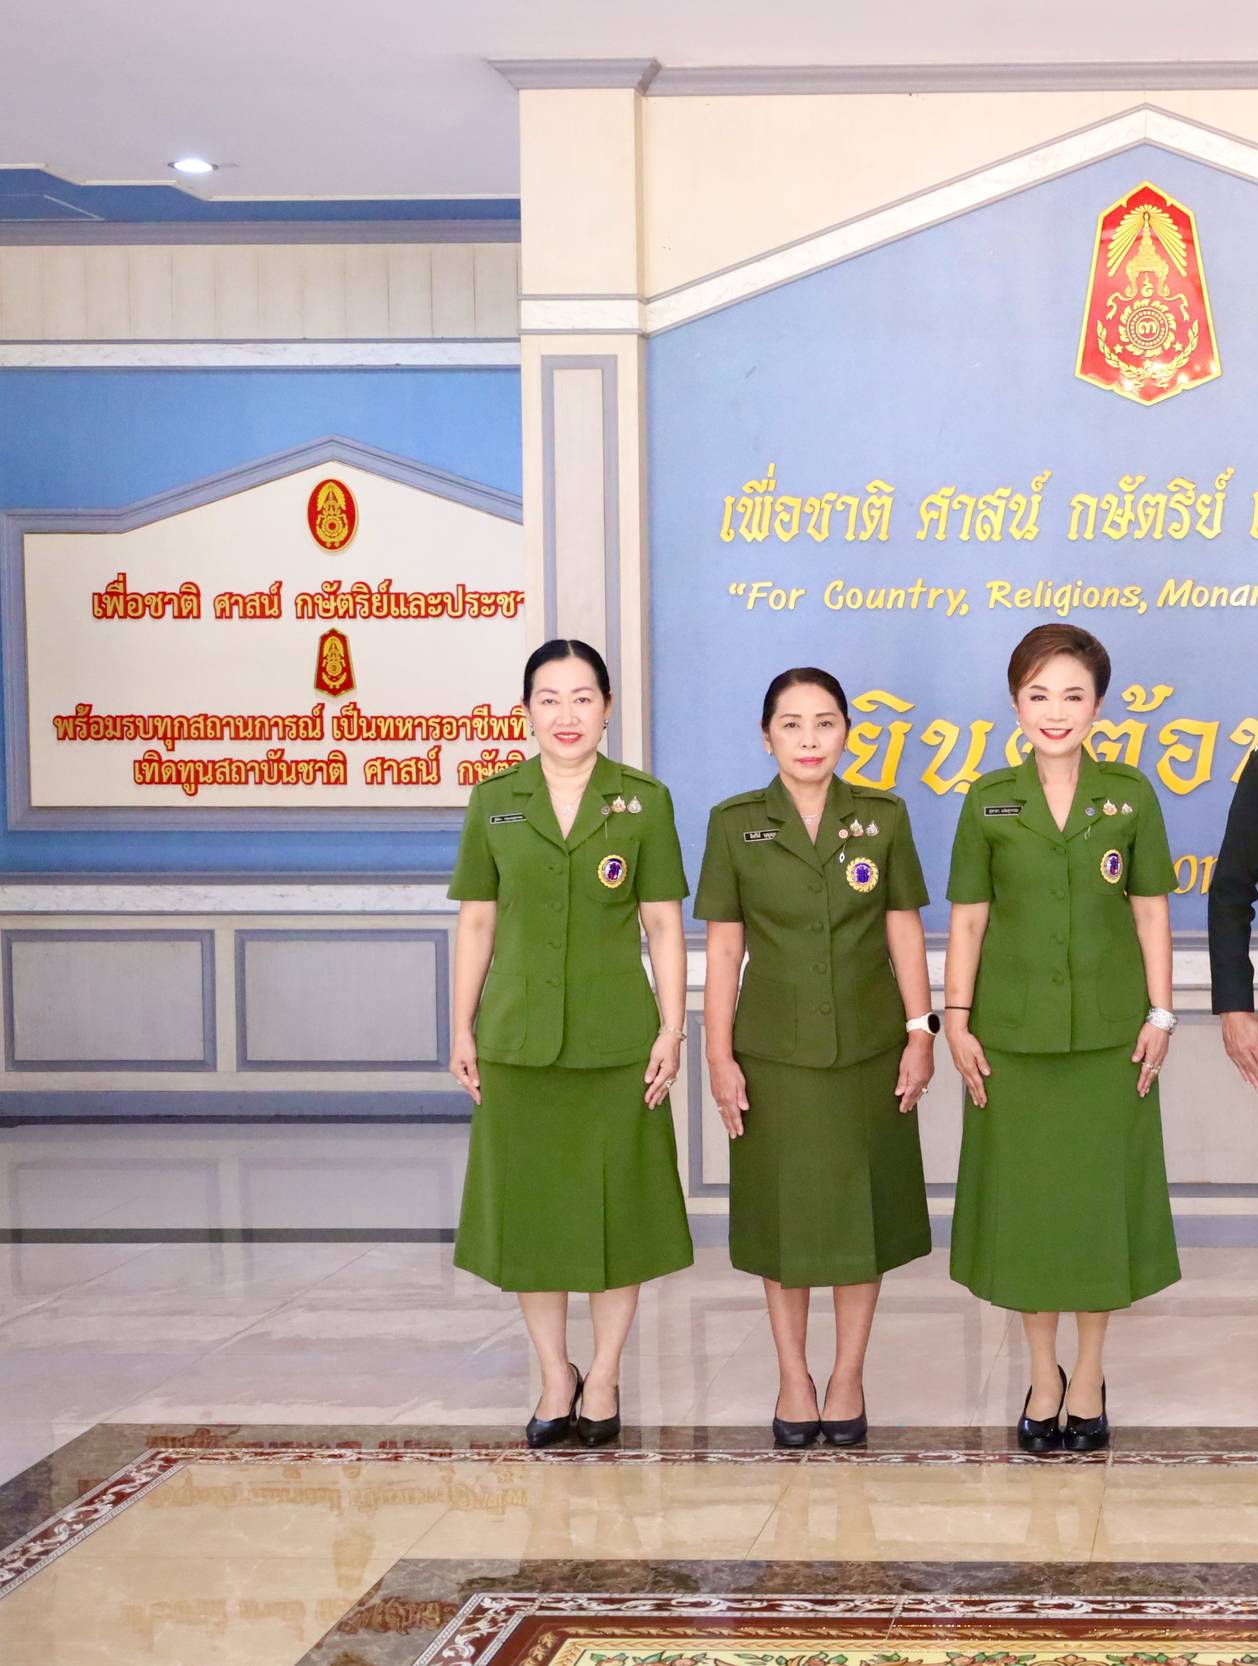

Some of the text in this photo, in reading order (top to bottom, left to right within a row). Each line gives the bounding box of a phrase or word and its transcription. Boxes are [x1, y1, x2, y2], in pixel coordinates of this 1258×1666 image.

[720, 463, 895, 542] เพื่อชาติ
[916, 470, 1052, 541] ศาสน์
[1068, 466, 1235, 541] กษัตริย์
[93, 572, 201, 619] เพื่อชาติ
[213, 580, 282, 619] ศาสน์
[824, 578, 970, 616] Country,
[986, 579, 1148, 616] Religions,
[53, 703, 325, 751] พร้อมรบทุกสถานการณ์
[133, 749, 347, 796] เทิดทูนสถาบันชาติ
[364, 745, 442, 785] ศาสน์
